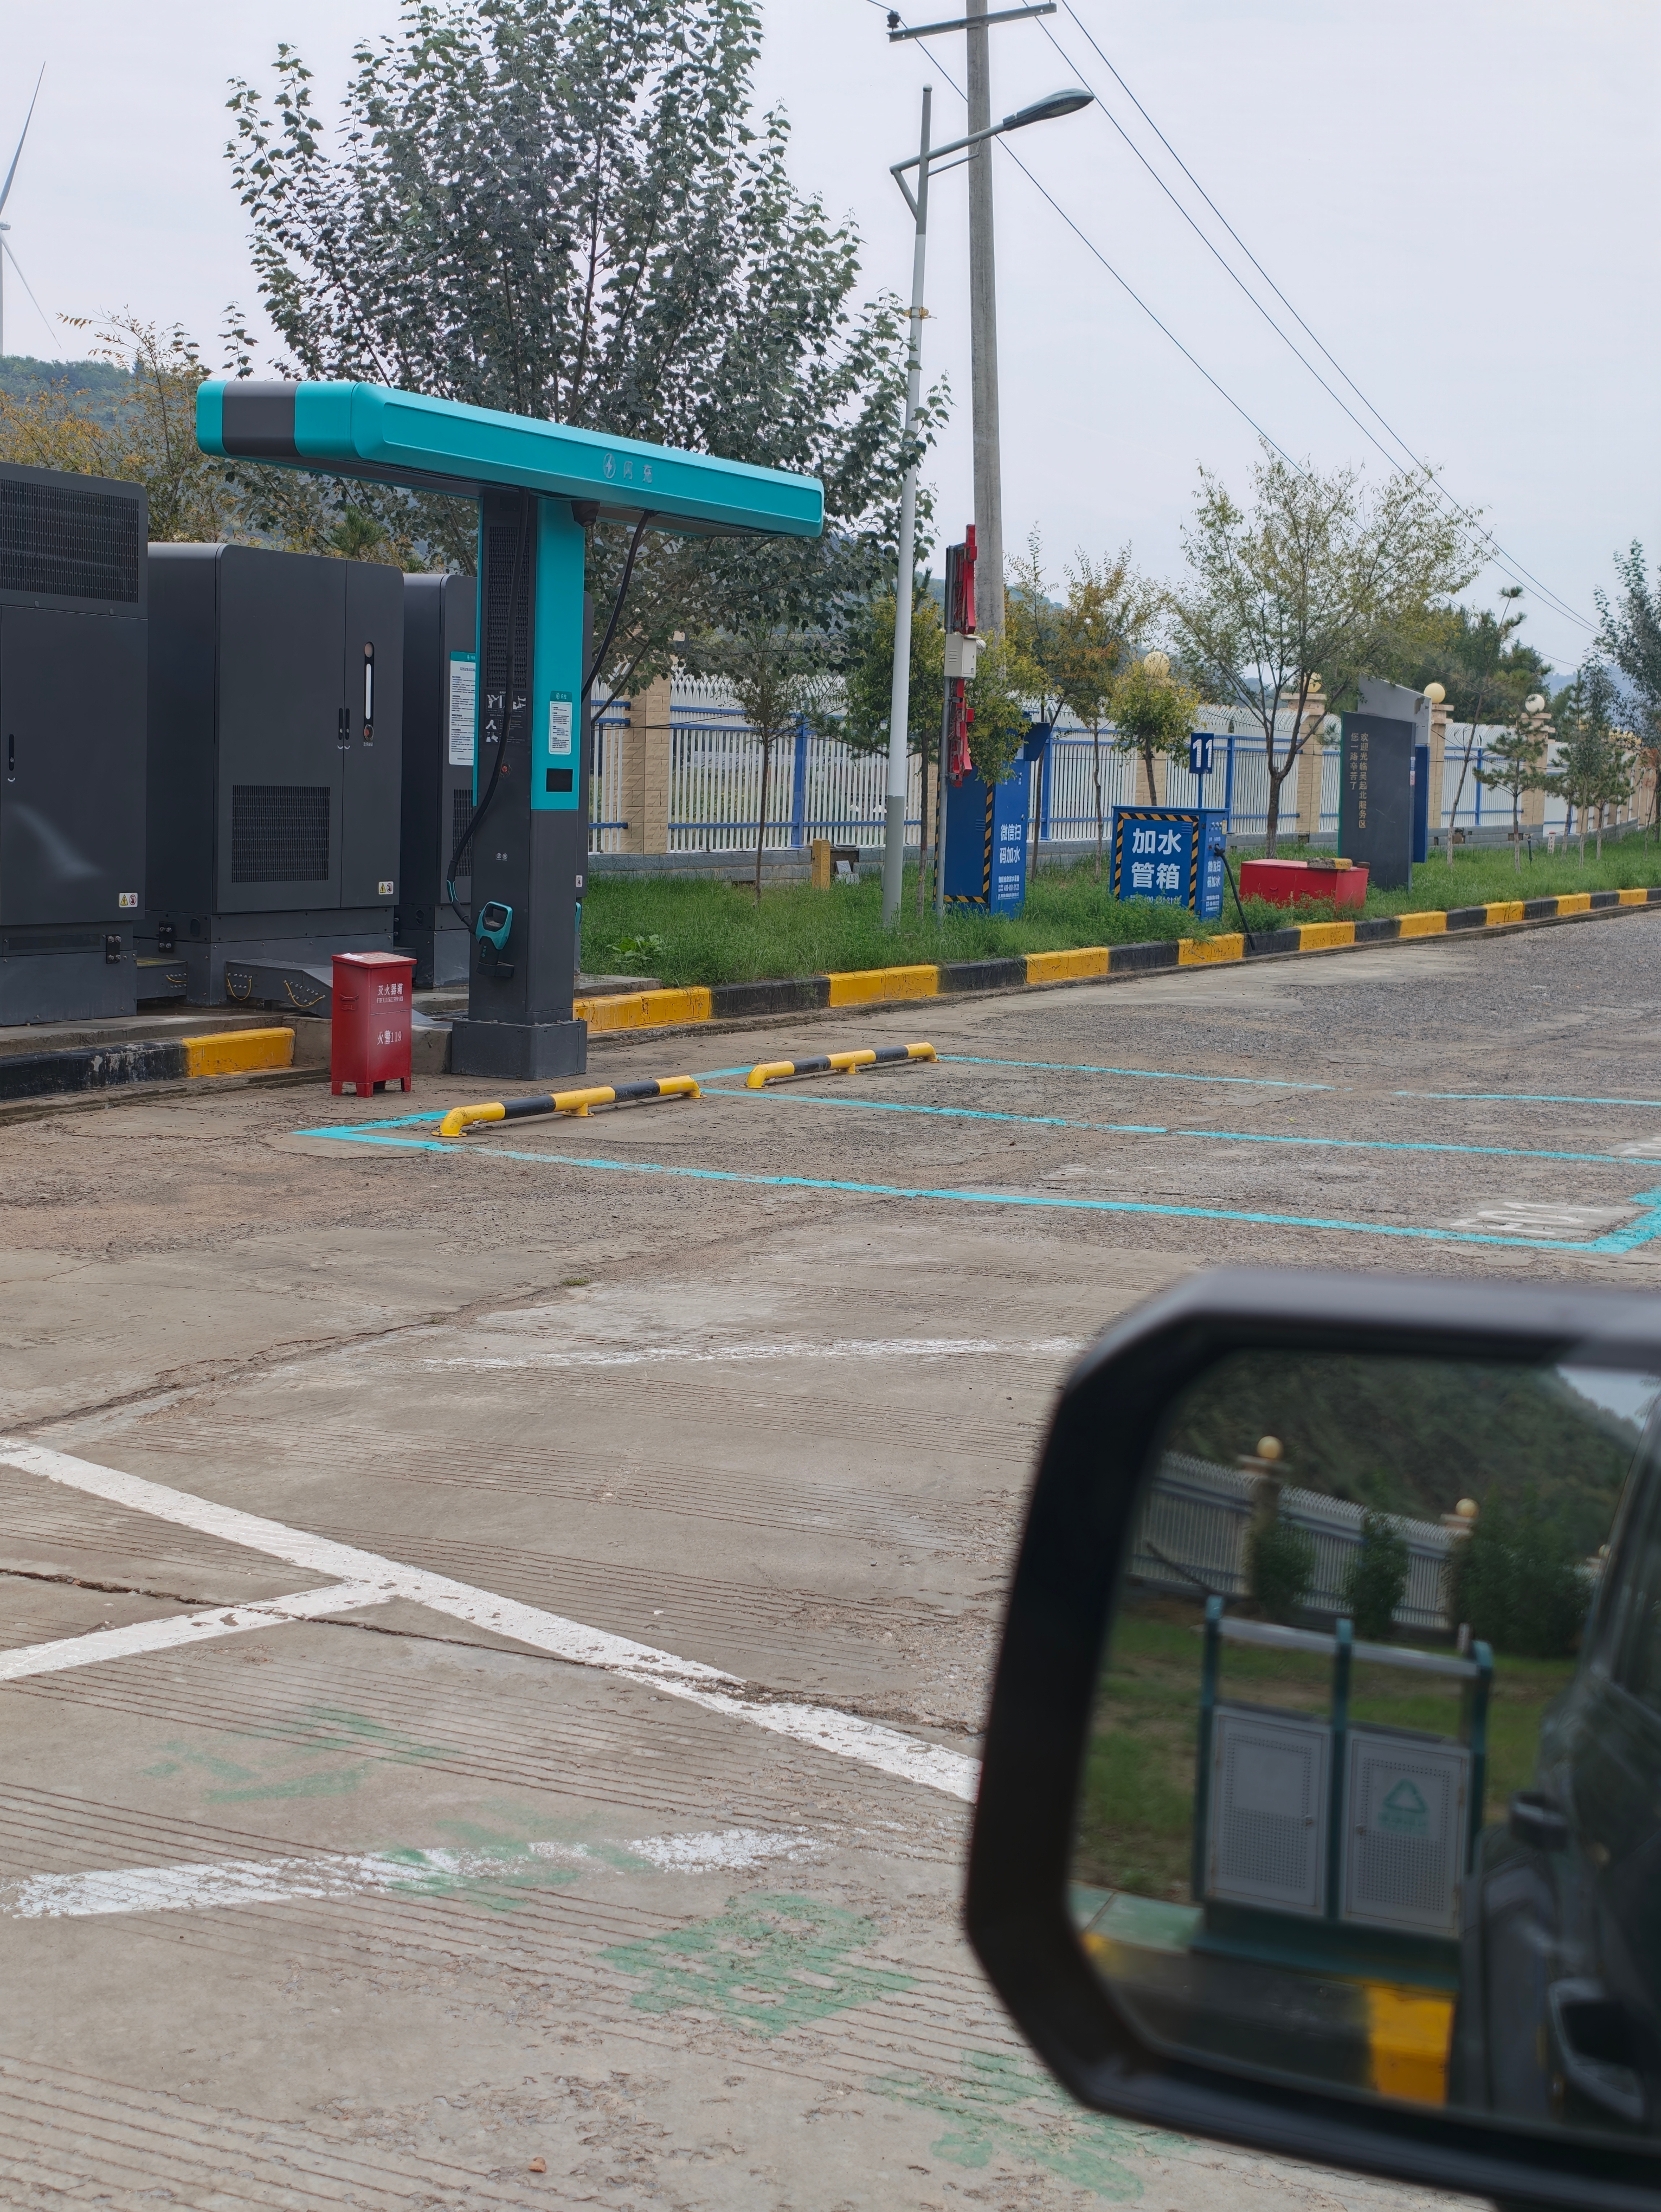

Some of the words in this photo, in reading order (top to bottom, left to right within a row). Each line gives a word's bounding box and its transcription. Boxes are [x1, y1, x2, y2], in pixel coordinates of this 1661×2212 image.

[1193, 739, 1213, 768] 11
[1349, 732, 1359, 790] 您一路辛苦了
[1358, 732, 1369, 828] 欢迎光临吴起北服务区
[1000, 824, 1022, 841] 微信扫
[1132, 828, 1182, 855] 加水
[1000, 846, 1021, 864] 码加水
[1208, 860, 1221, 872] 微信扫
[1131, 862, 1180, 890] 管箱
[1207, 875, 1220, 888] 码加水
[378, 983, 403, 996] 灭火器箱
[377, 1030, 402, 1045] 火警119
